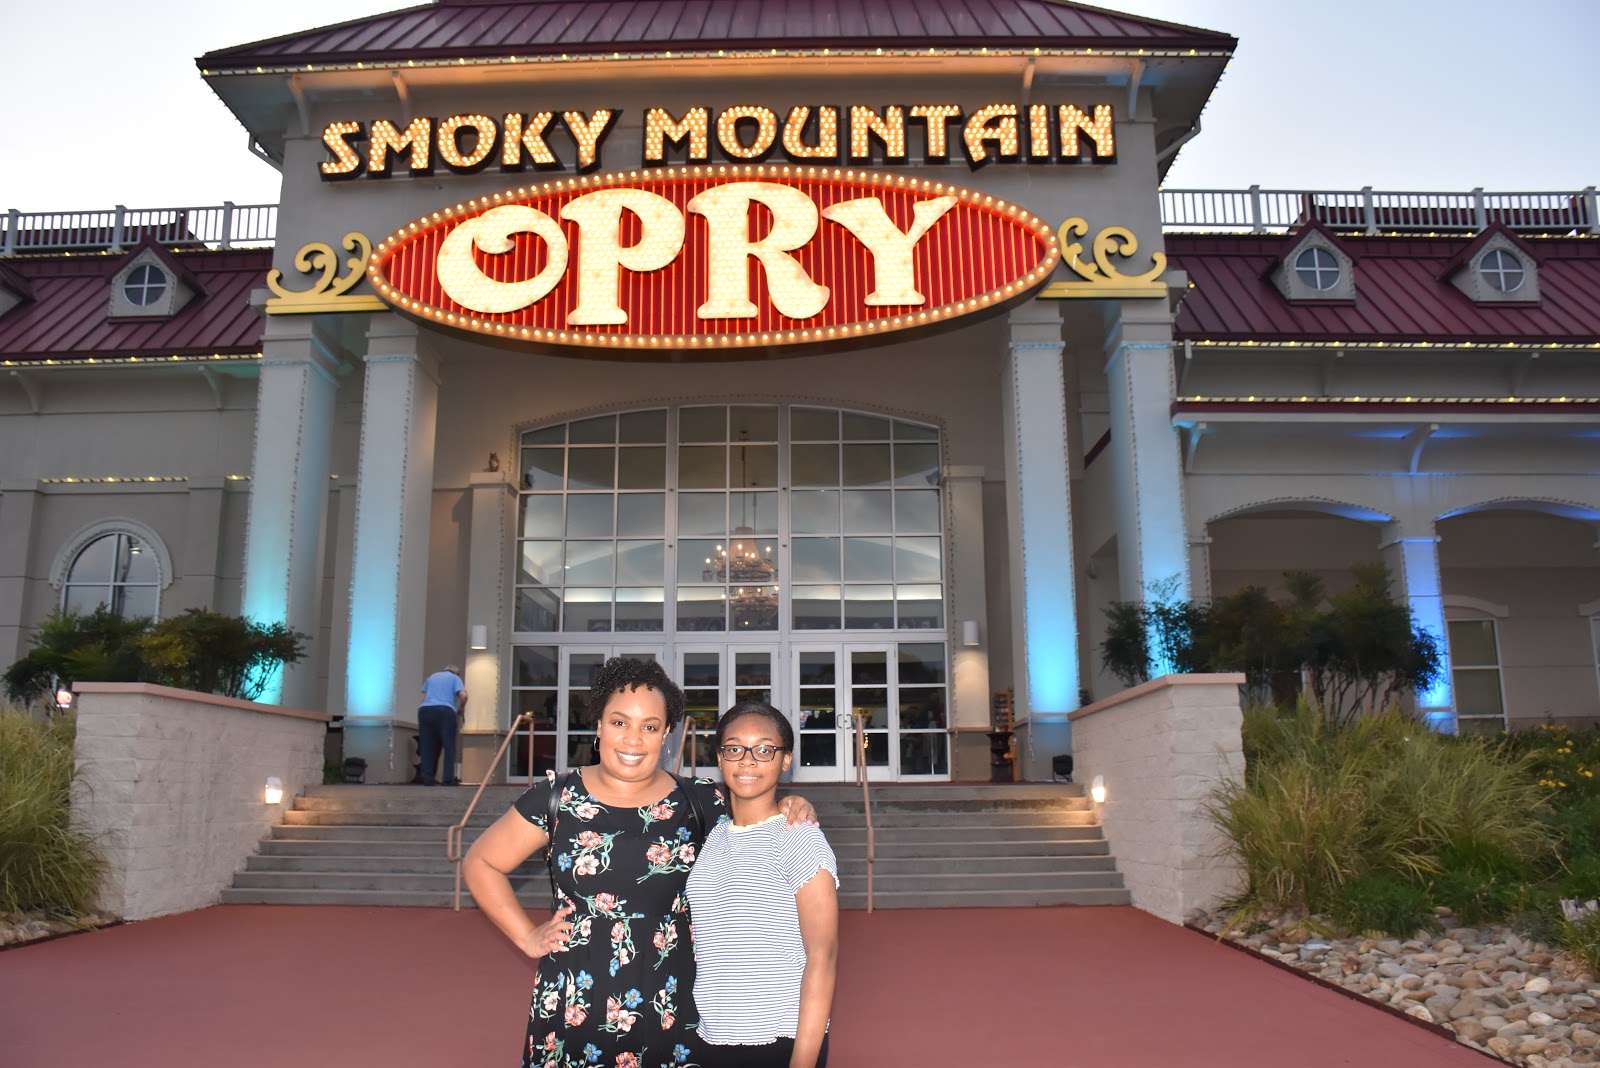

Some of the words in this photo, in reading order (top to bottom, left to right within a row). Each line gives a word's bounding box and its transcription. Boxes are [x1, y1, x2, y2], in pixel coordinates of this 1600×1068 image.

[320, 109, 617, 177] SMOKY
[643, 103, 1114, 166] MOUNTAIN
[436, 180, 959, 326] OPRY
